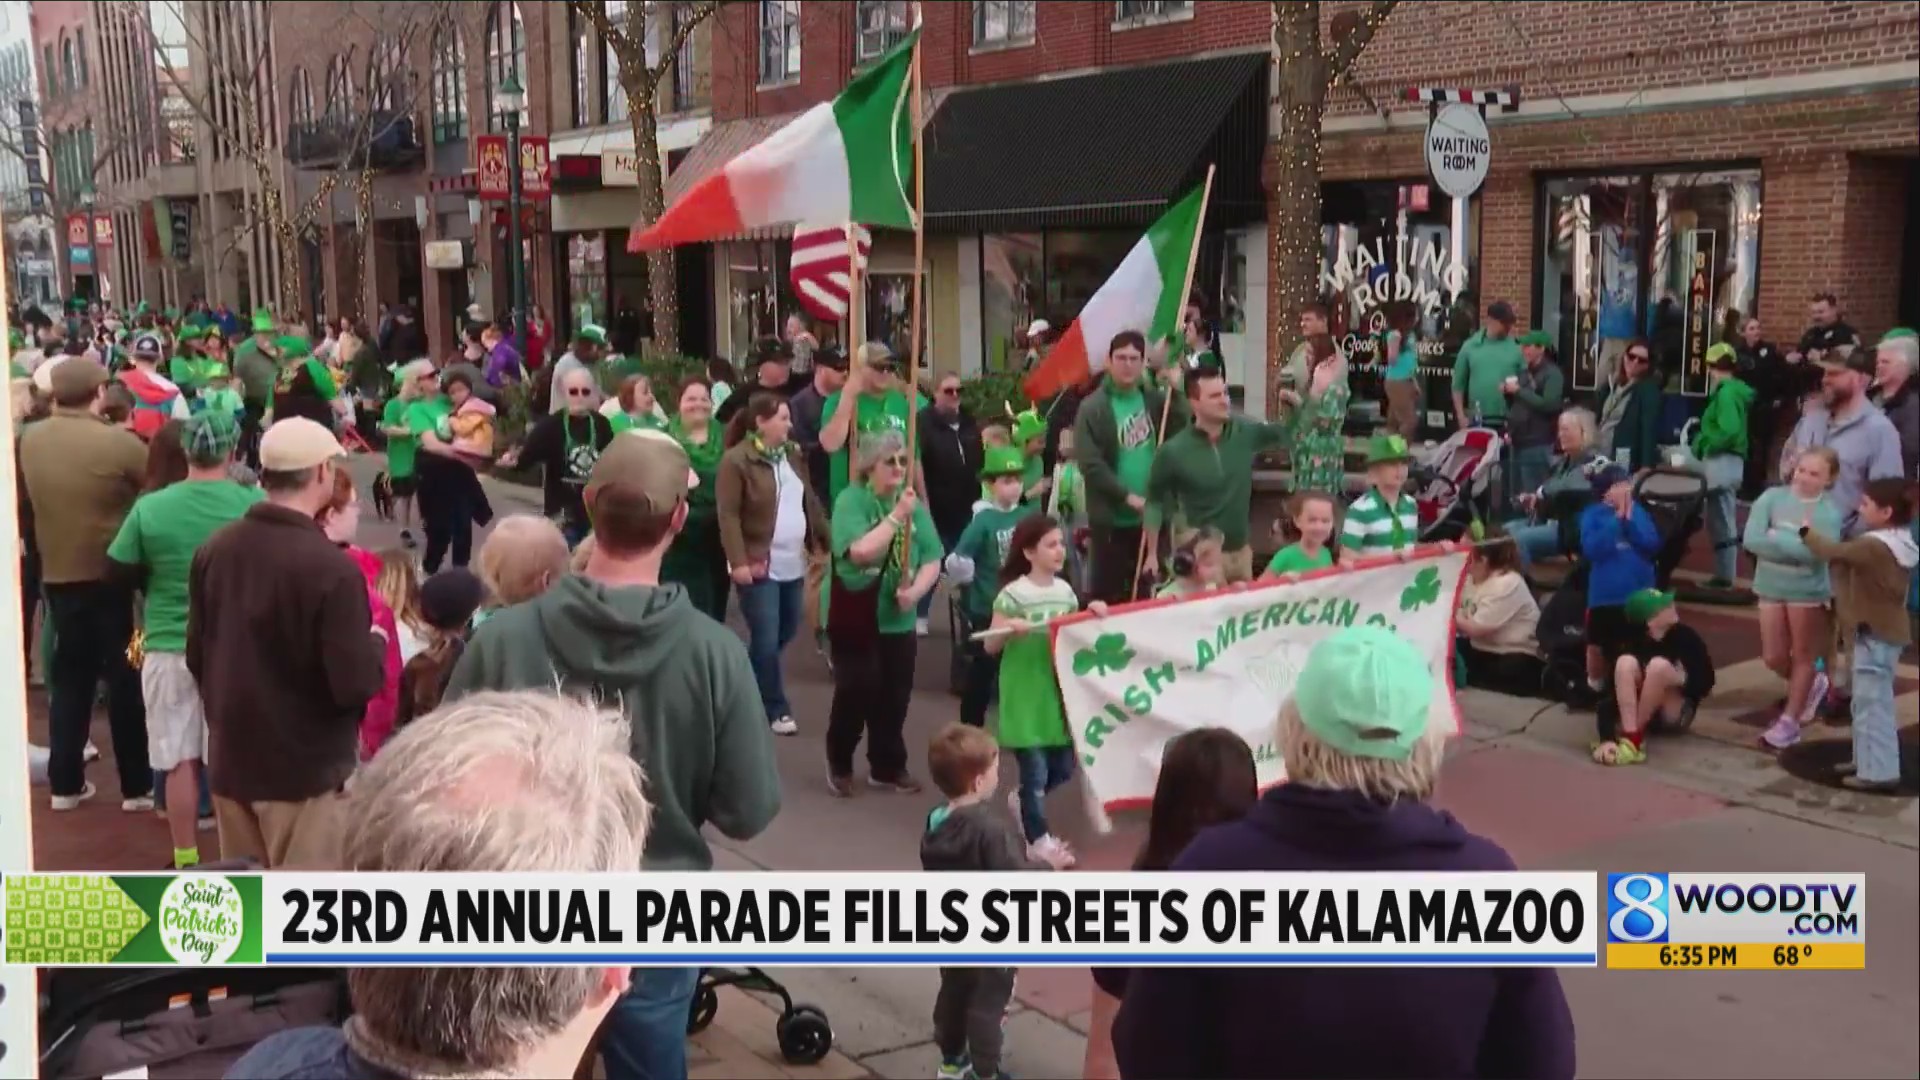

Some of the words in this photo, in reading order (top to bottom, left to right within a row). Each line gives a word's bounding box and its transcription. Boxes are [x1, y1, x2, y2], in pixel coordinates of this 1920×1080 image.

[1431, 138, 1488, 154] WAITING
[1443, 156, 1476, 171] ROOM
[1319, 236, 1468, 306] WAITING
[1691, 251, 1706, 374] BARBER
